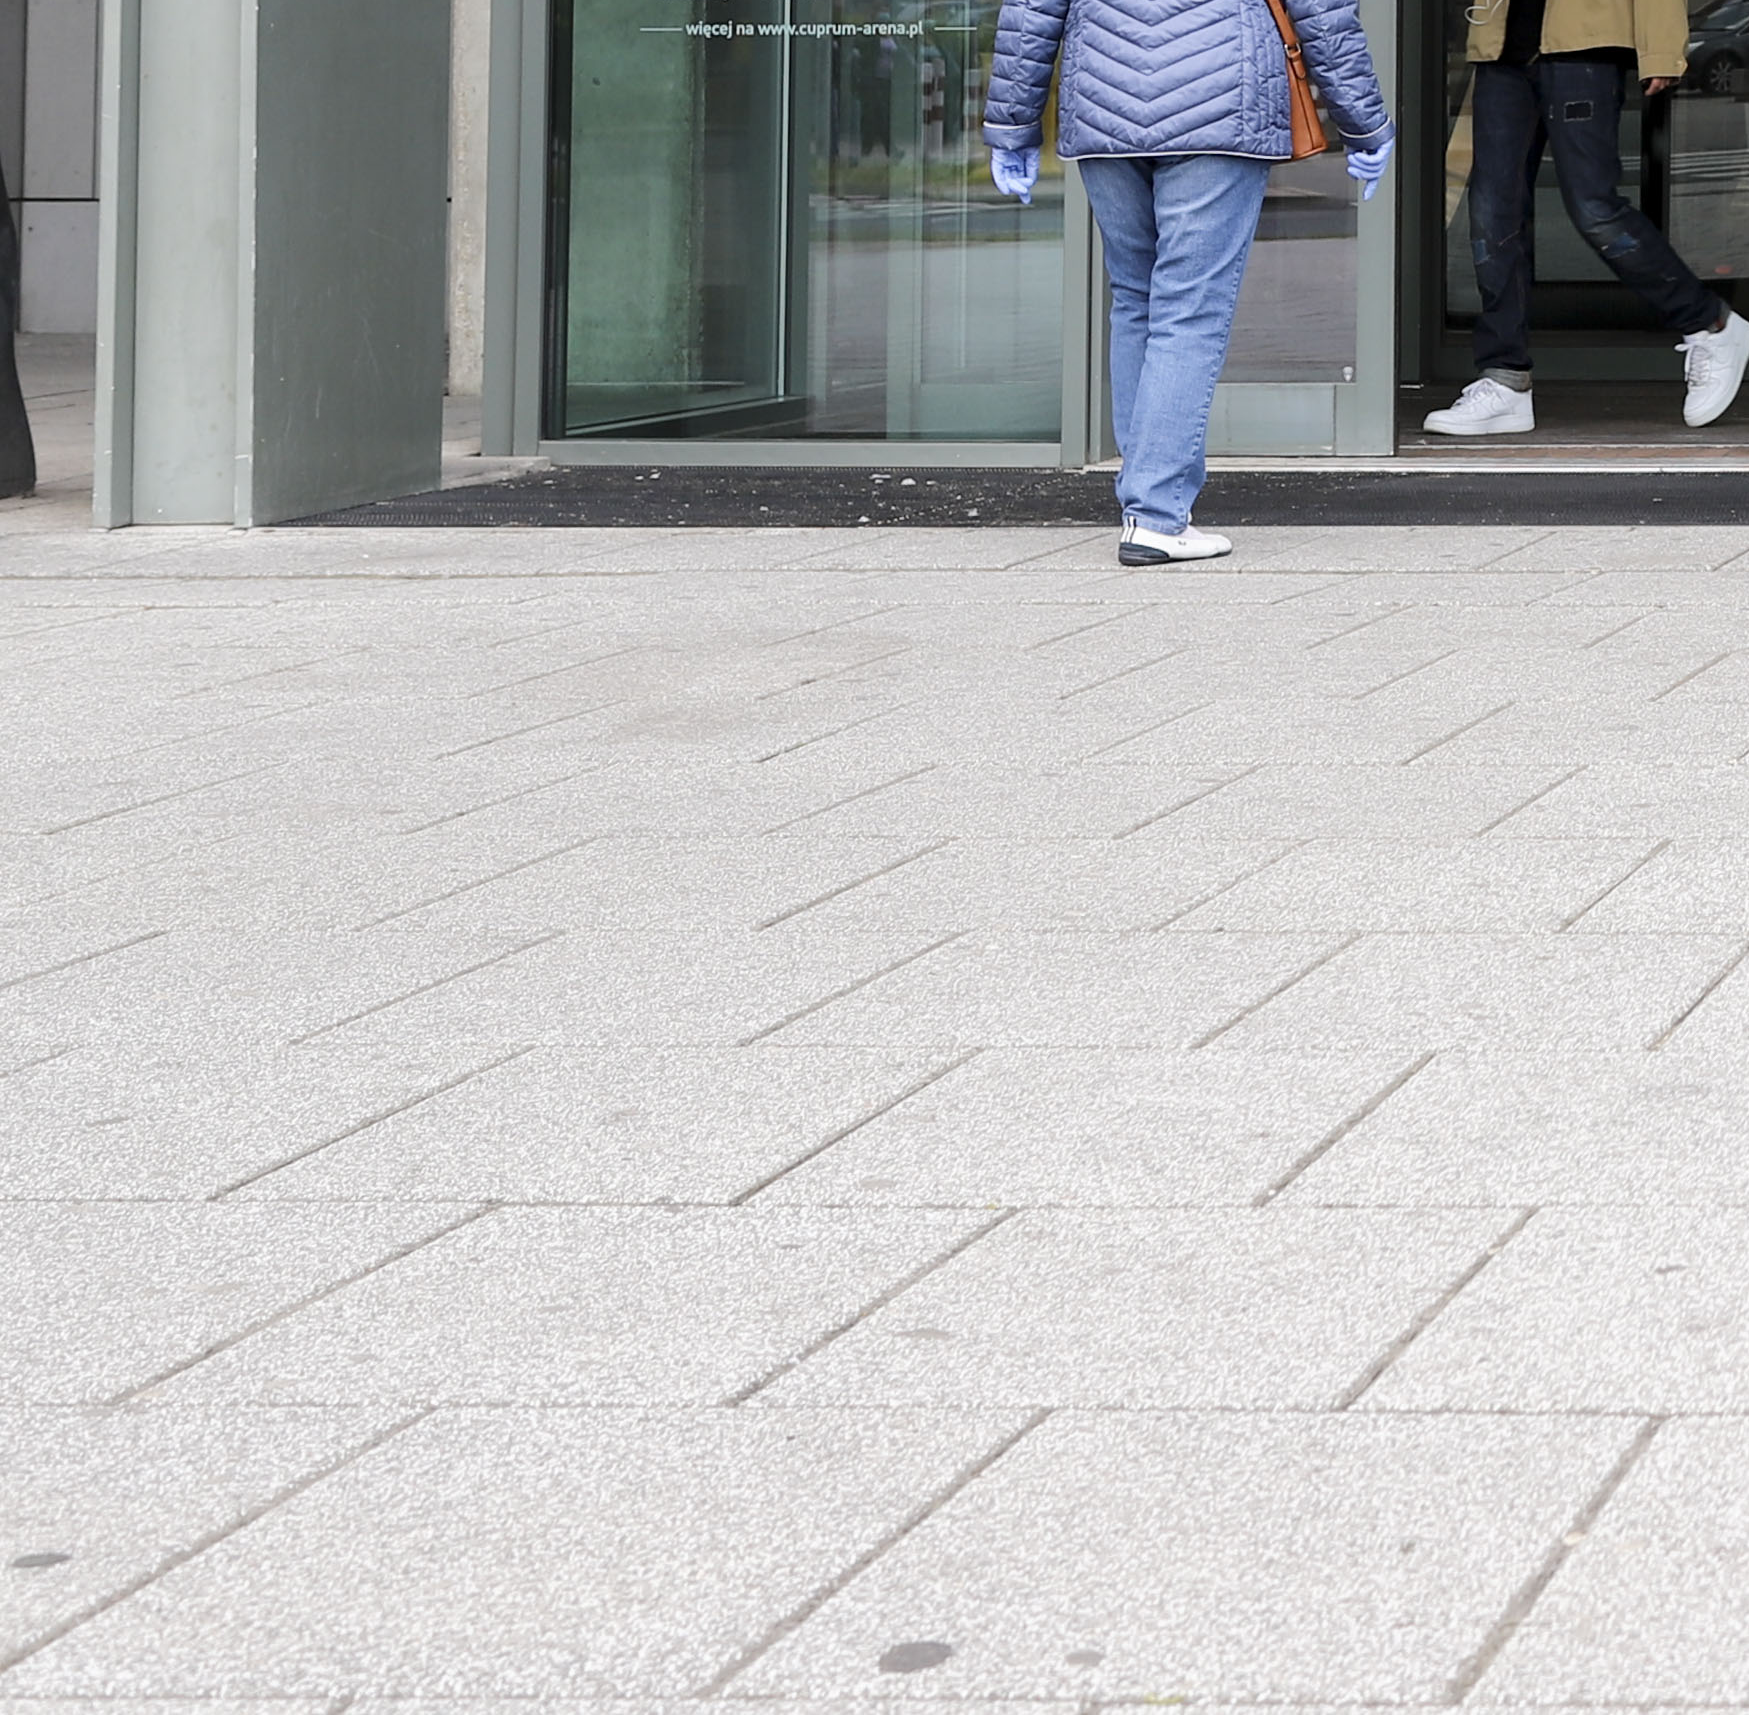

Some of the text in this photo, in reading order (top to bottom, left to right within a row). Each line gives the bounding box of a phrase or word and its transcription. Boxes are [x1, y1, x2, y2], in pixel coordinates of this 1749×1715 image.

[685, 21, 923, 38] więcej na www.cuprum-arena.pl
